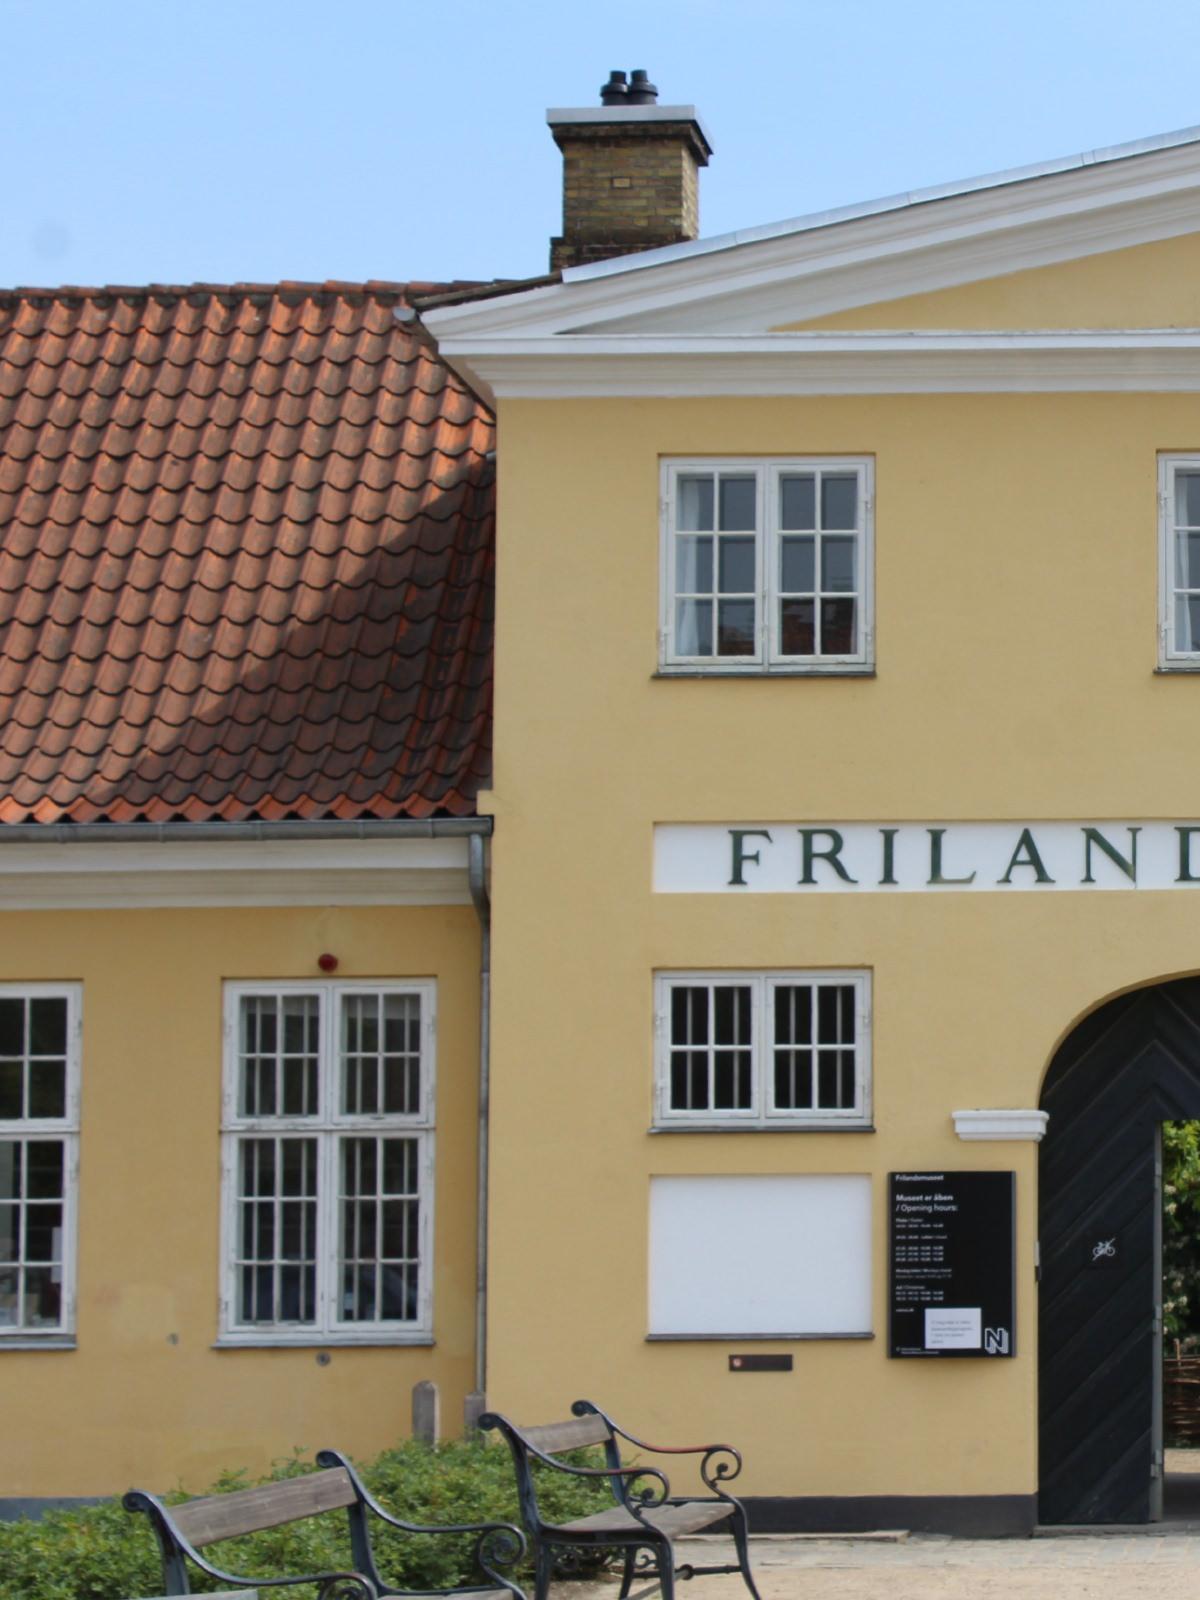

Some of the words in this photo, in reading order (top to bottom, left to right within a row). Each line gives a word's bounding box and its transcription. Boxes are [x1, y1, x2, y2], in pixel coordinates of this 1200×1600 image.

[895, 1174, 945, 1182] Frilandsmuseet
[933, 1193, 954, 1201] åben
[900, 1204, 933, 1213] Opening
